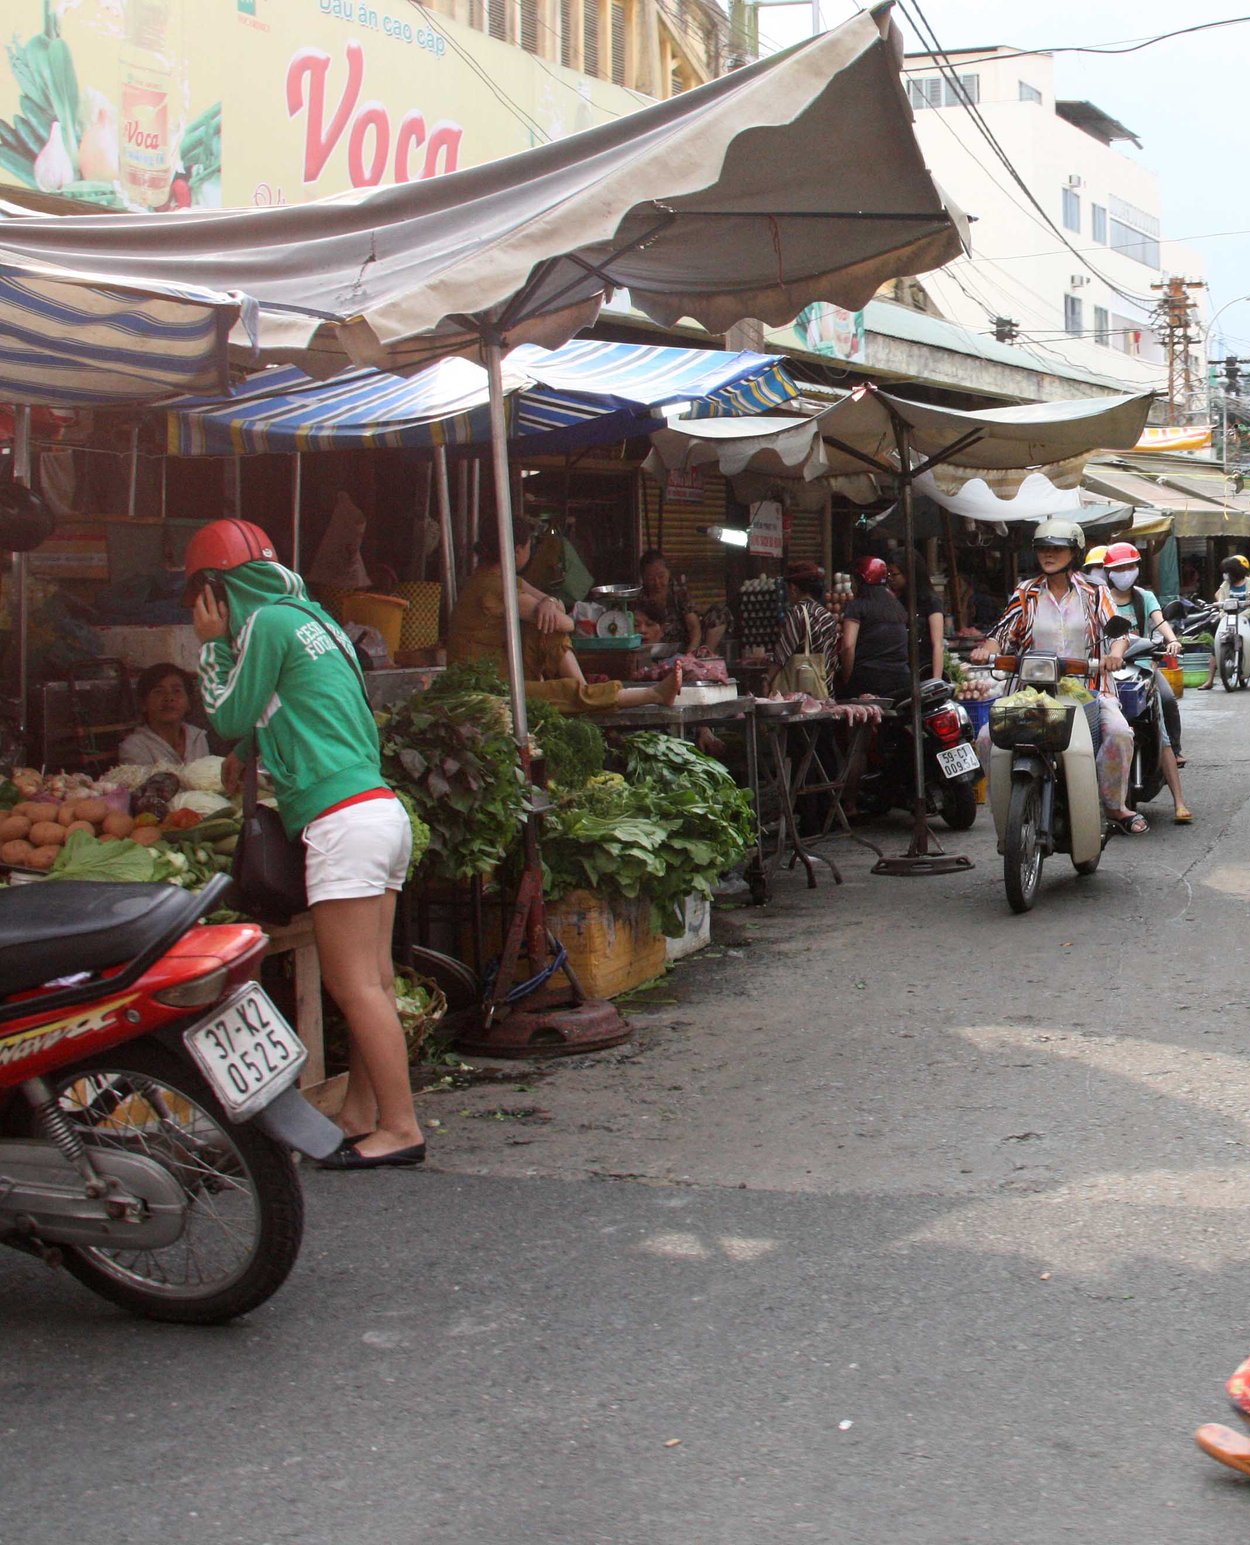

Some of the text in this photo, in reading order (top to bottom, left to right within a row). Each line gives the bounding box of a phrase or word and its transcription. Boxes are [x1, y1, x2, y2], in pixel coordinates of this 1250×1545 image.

[383, 15, 412, 43] cao
[127, 121, 160, 150] Voca
[286, 38, 463, 188] Voca
[205, 997, 271, 1061] 37-K2
[226, 1029, 292, 1095] 0525
